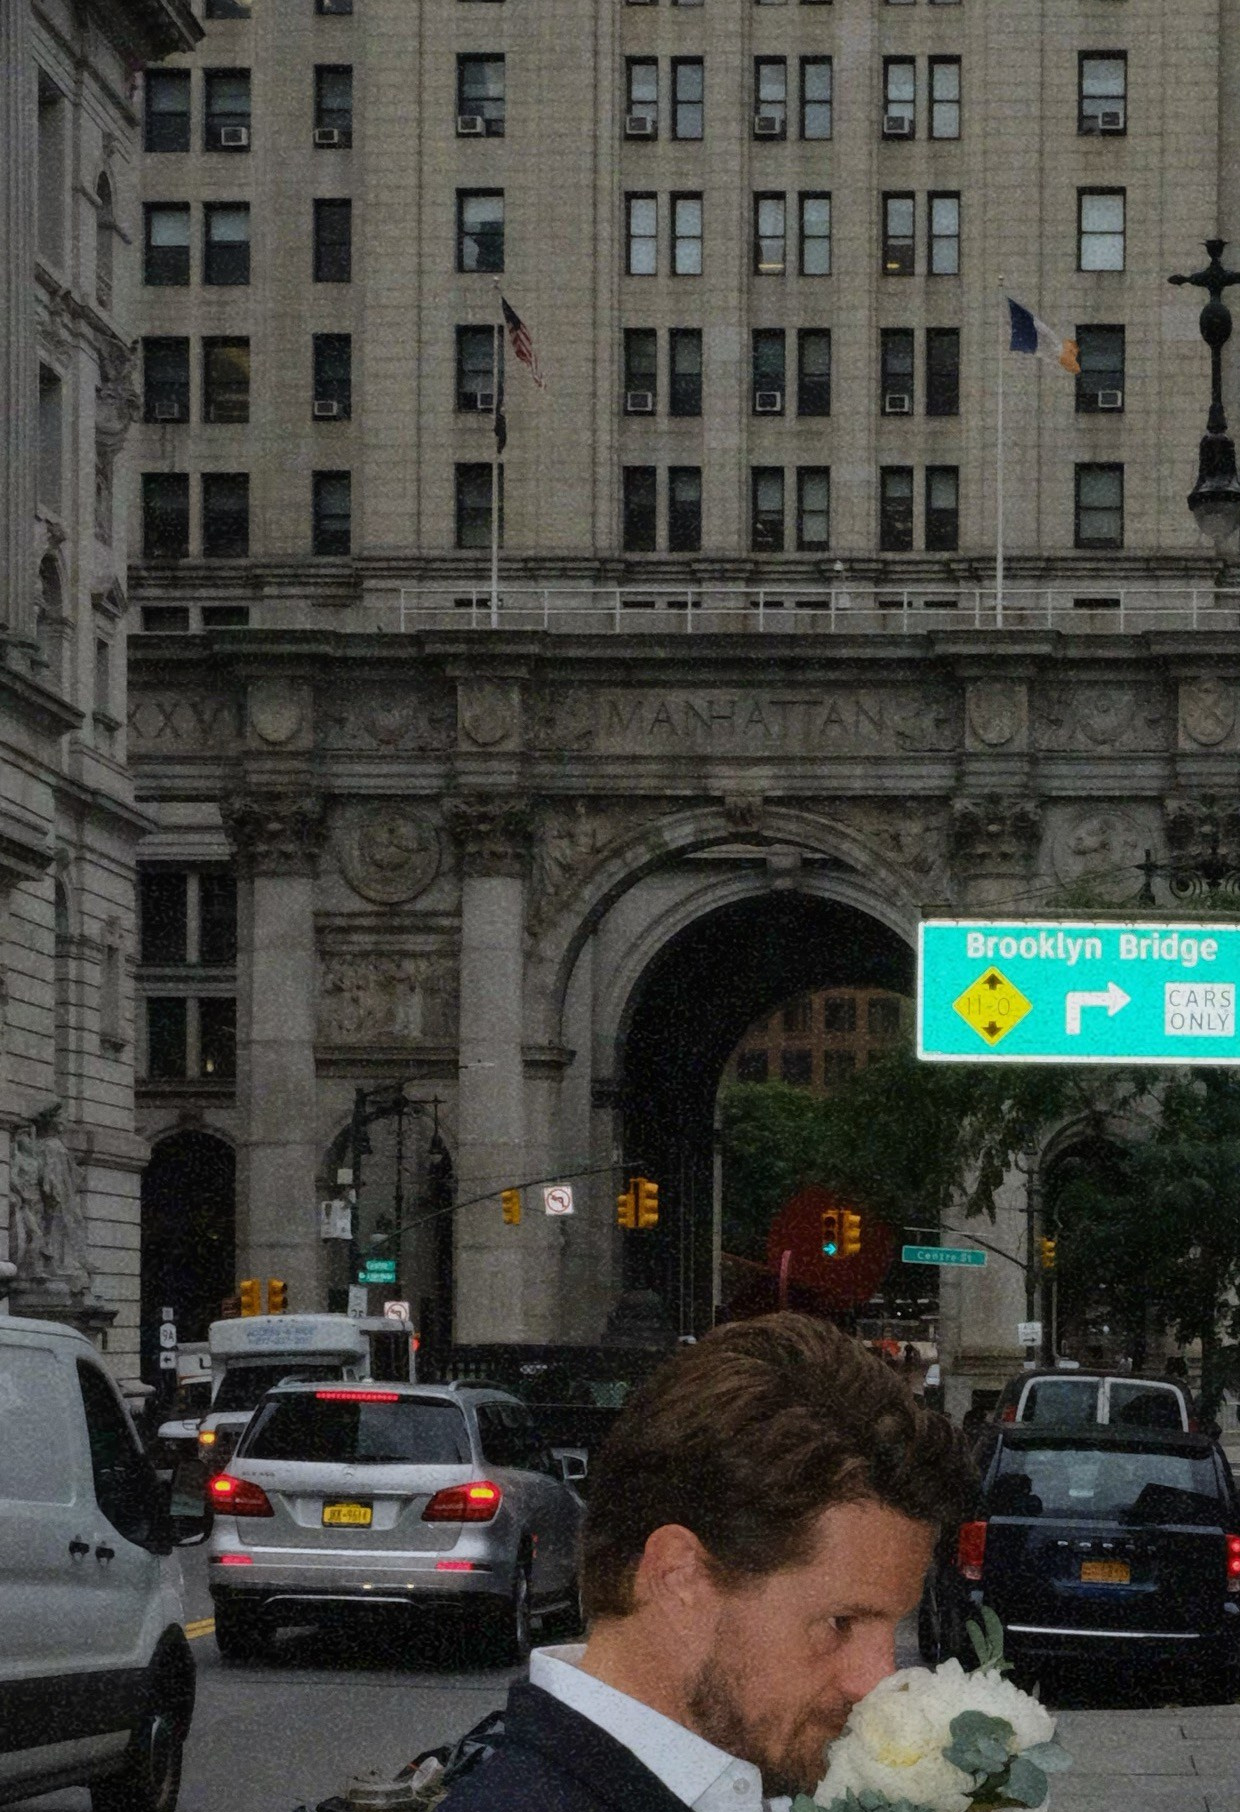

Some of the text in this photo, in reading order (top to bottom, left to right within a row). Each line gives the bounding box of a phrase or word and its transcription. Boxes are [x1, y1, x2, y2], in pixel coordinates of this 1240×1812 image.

[605, 699, 885, 737] MANHATTAN
[966, 932, 1219, 968] Brooklyn Bridge
[1169, 989, 1231, 1008] CARS
[1170, 1012, 1230, 1031] ONLY
[917, 1250, 957, 1262] Centre
[162, 1329, 174, 1342] 9A
